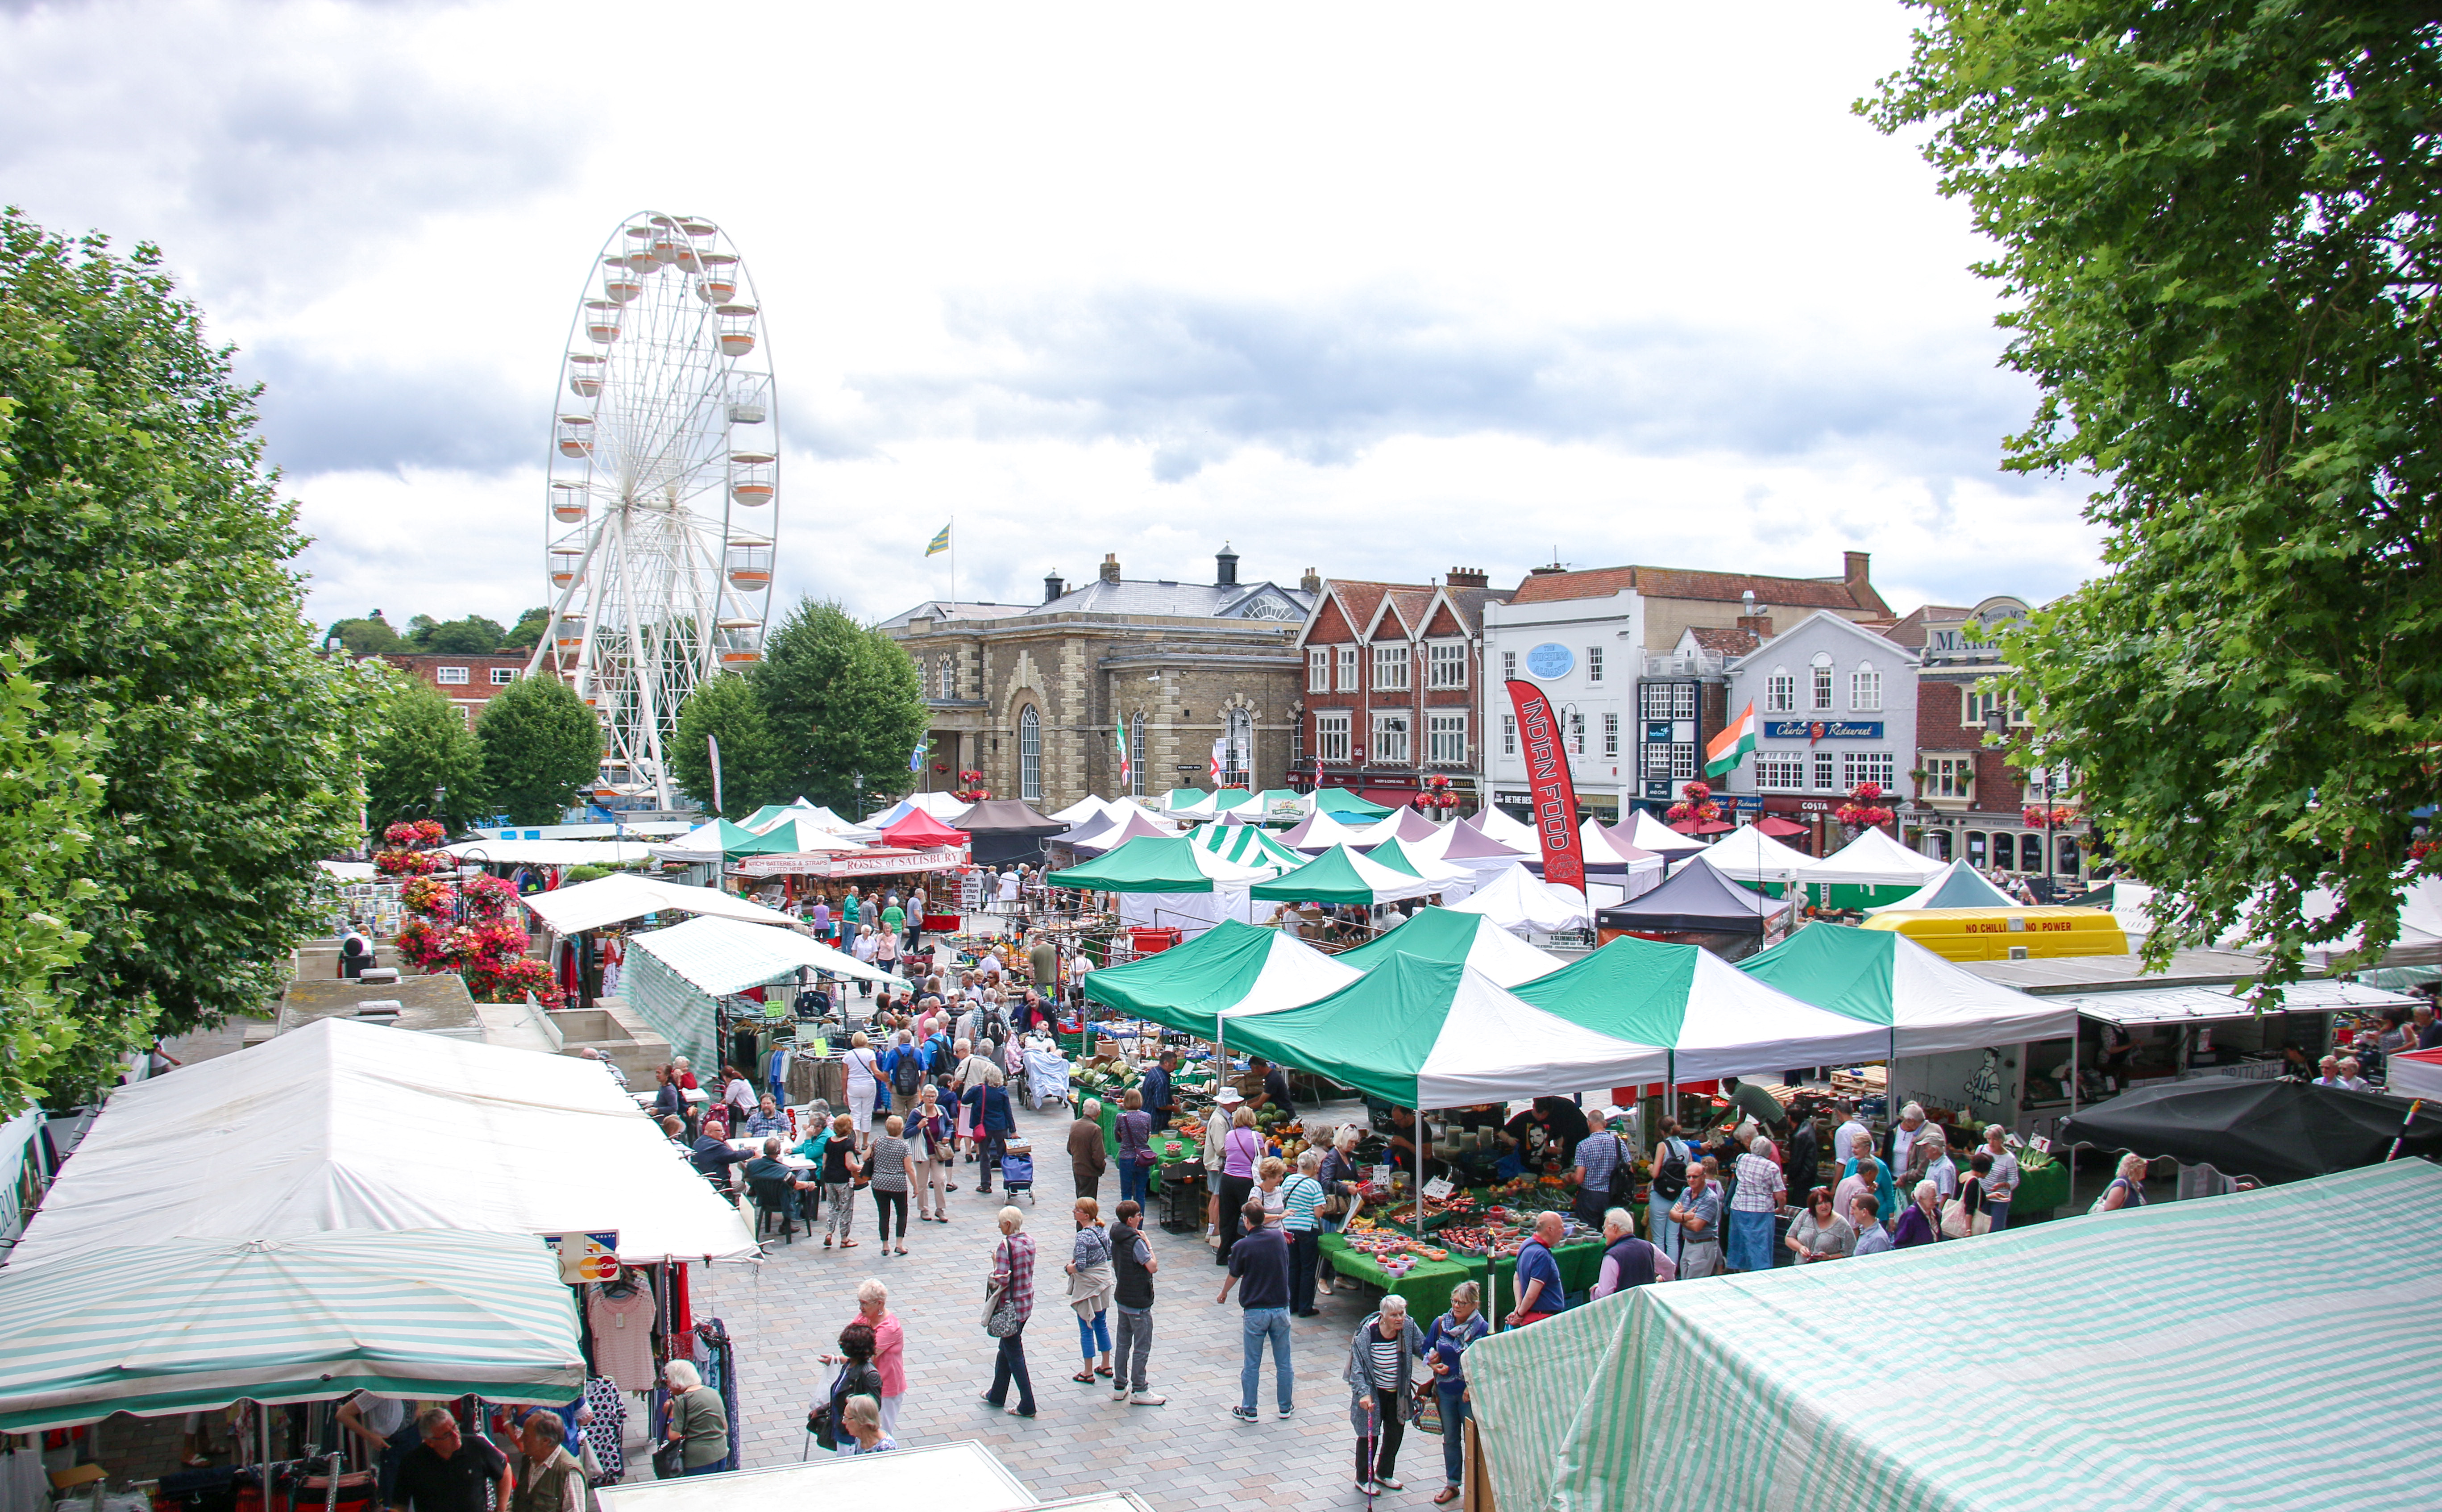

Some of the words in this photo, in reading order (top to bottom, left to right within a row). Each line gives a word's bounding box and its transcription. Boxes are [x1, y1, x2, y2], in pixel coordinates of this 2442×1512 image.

[1531, 651, 1568, 662] DUCHESS
[1532, 663, 1566, 677] ALBANY
[1776, 723, 1807, 735] Charter
[1828, 724, 1872, 735] Restaurant
[1521, 697, 1557, 780] INDIAN
[1504, 795, 1512, 803] BE
[1512, 795, 1522, 804] THE
[1522, 796, 1533, 804] BES
[1802, 802, 1828, 810] COSTA
[1538, 782, 1570, 851] FOOD
[847, 859, 882, 870] ROSES
[885, 858, 895, 867] of
[898, 852, 958, 866] SALISBURY
[1546, 859, 1579, 871] CURRY
[1553, 869, 1577, 878] MAN
[1966, 924, 1977, 933] NO
[1980, 923, 2006, 933] CHILLI
[2025, 922, 2036, 931] NO
[2042, 922, 2072, 931] POWER
